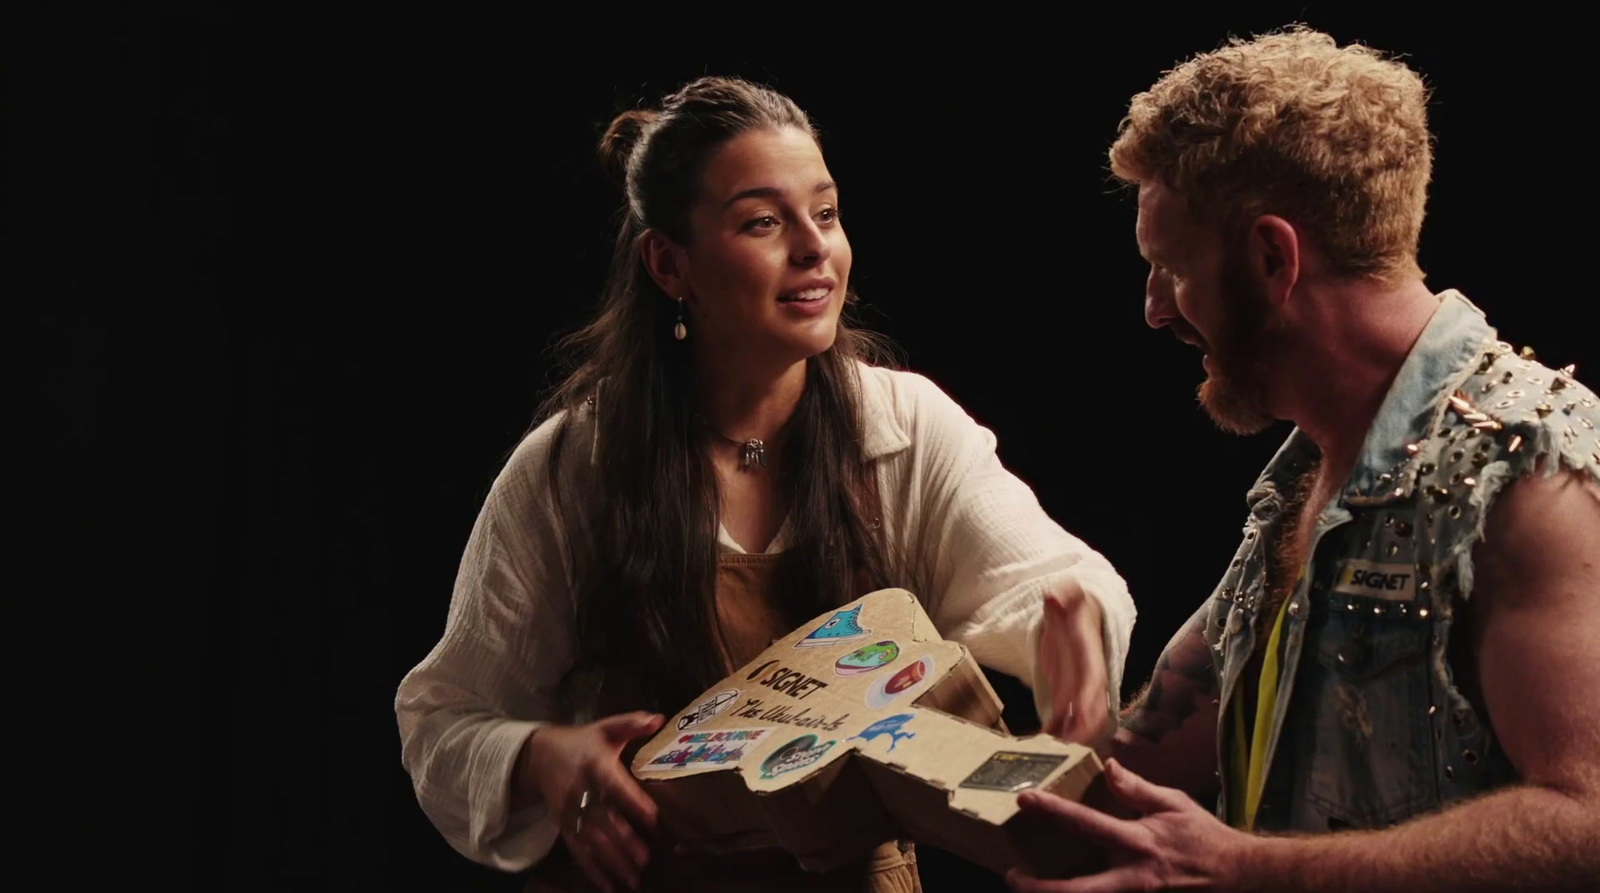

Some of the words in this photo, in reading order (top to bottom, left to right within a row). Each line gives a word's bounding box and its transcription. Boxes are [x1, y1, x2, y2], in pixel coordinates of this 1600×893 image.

[1351, 569, 1410, 591] SIGNET
[761, 667, 828, 700] SIGNET
[730, 698, 763, 719] The
[689, 729, 766, 743] MELBOURNE
